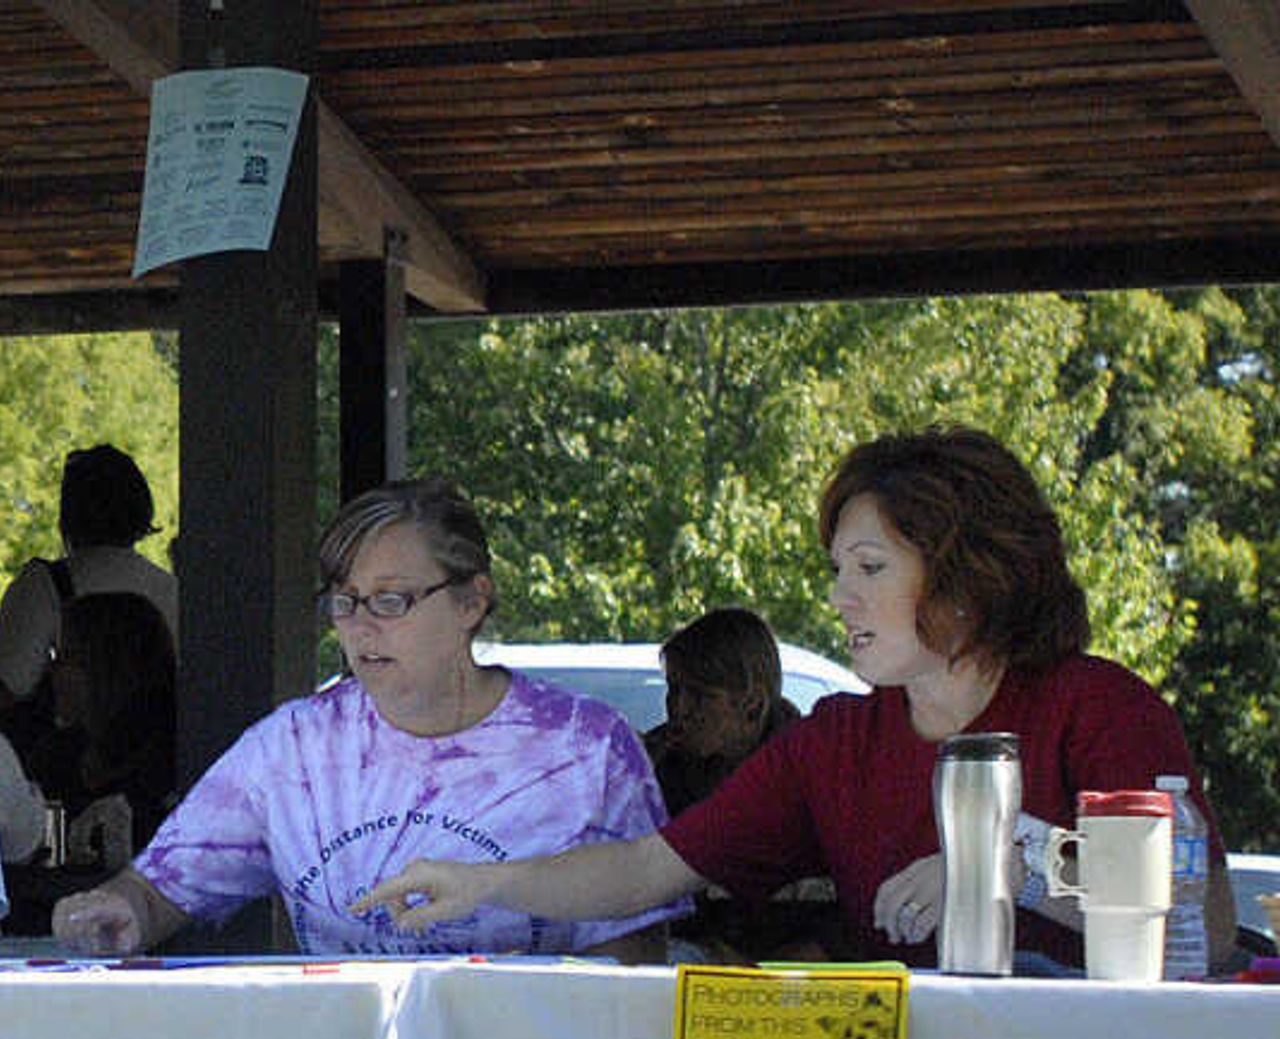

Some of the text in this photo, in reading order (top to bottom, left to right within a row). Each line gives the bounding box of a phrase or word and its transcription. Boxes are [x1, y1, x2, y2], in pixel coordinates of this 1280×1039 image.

[320, 813, 398, 864] Distance
[405, 809, 435, 827] for
[441, 813, 510, 862] Victims
[690, 1014, 808, 1037] FROM THIS
